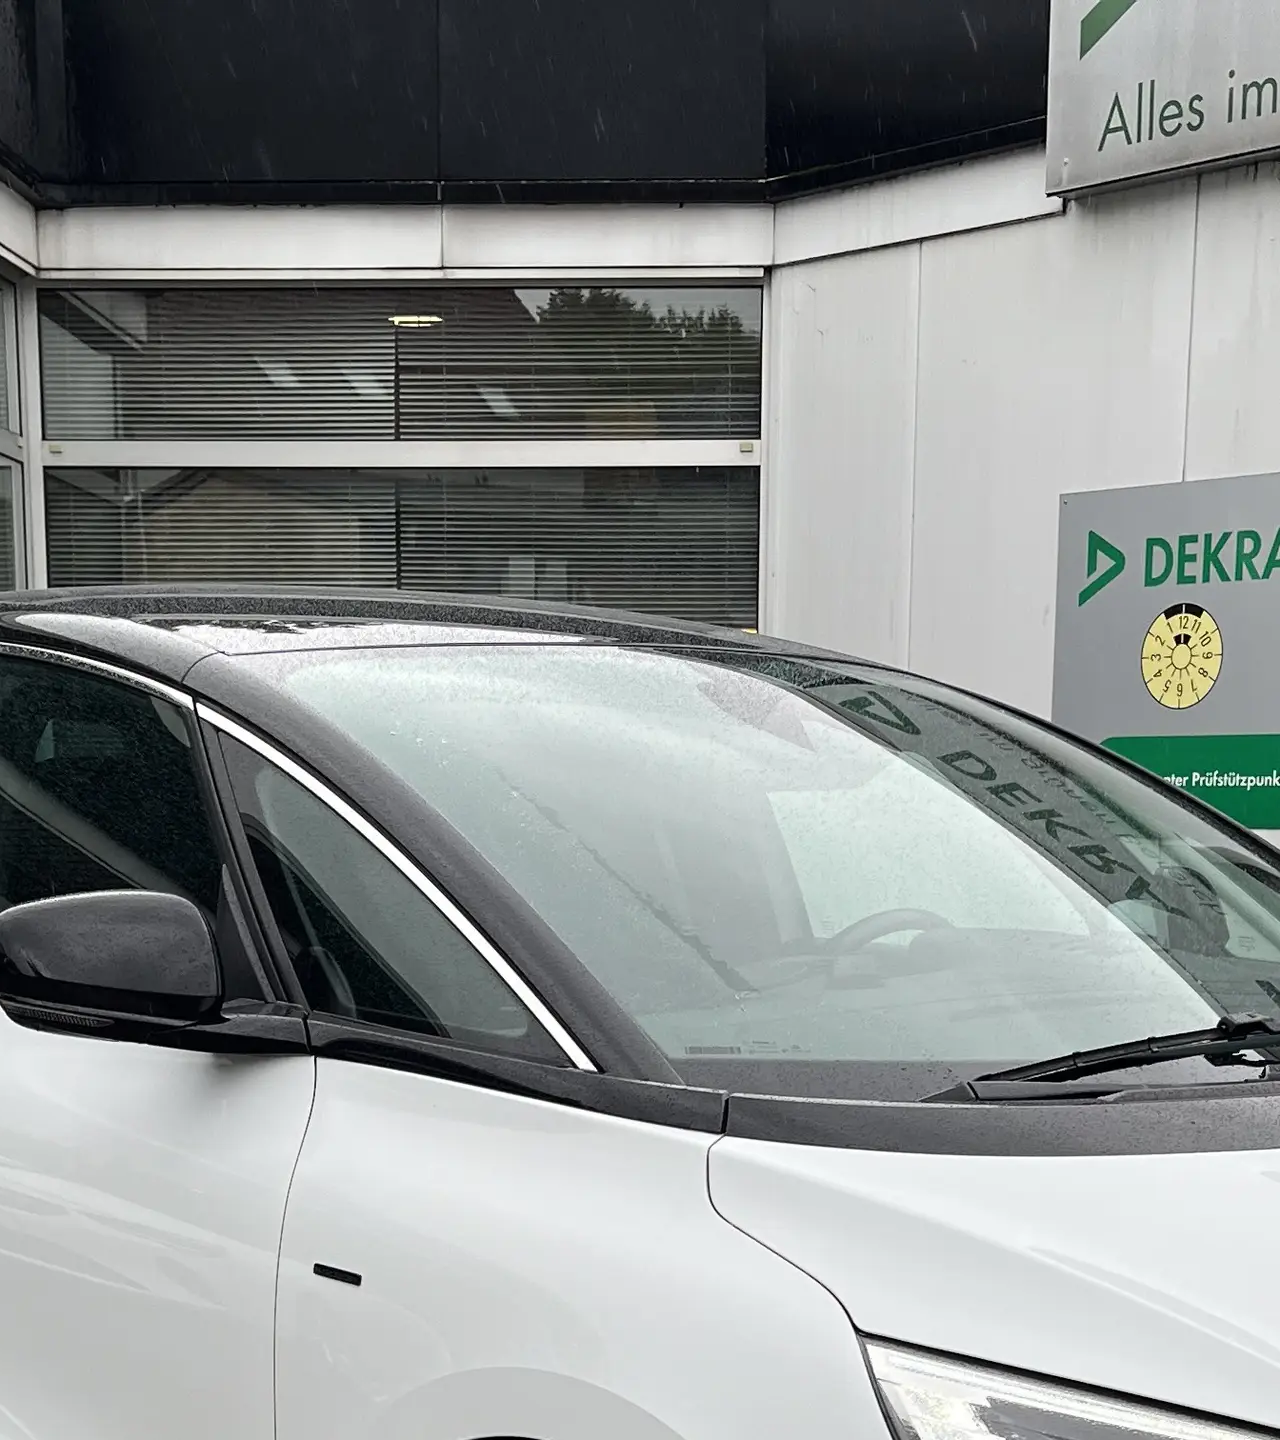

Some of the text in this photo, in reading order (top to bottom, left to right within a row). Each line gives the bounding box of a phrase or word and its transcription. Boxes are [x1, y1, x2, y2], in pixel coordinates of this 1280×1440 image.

[1097, 79, 1206, 152] Alles
[1227, 70, 1279, 123] im
[1178, 615, 1190, 630] 12
